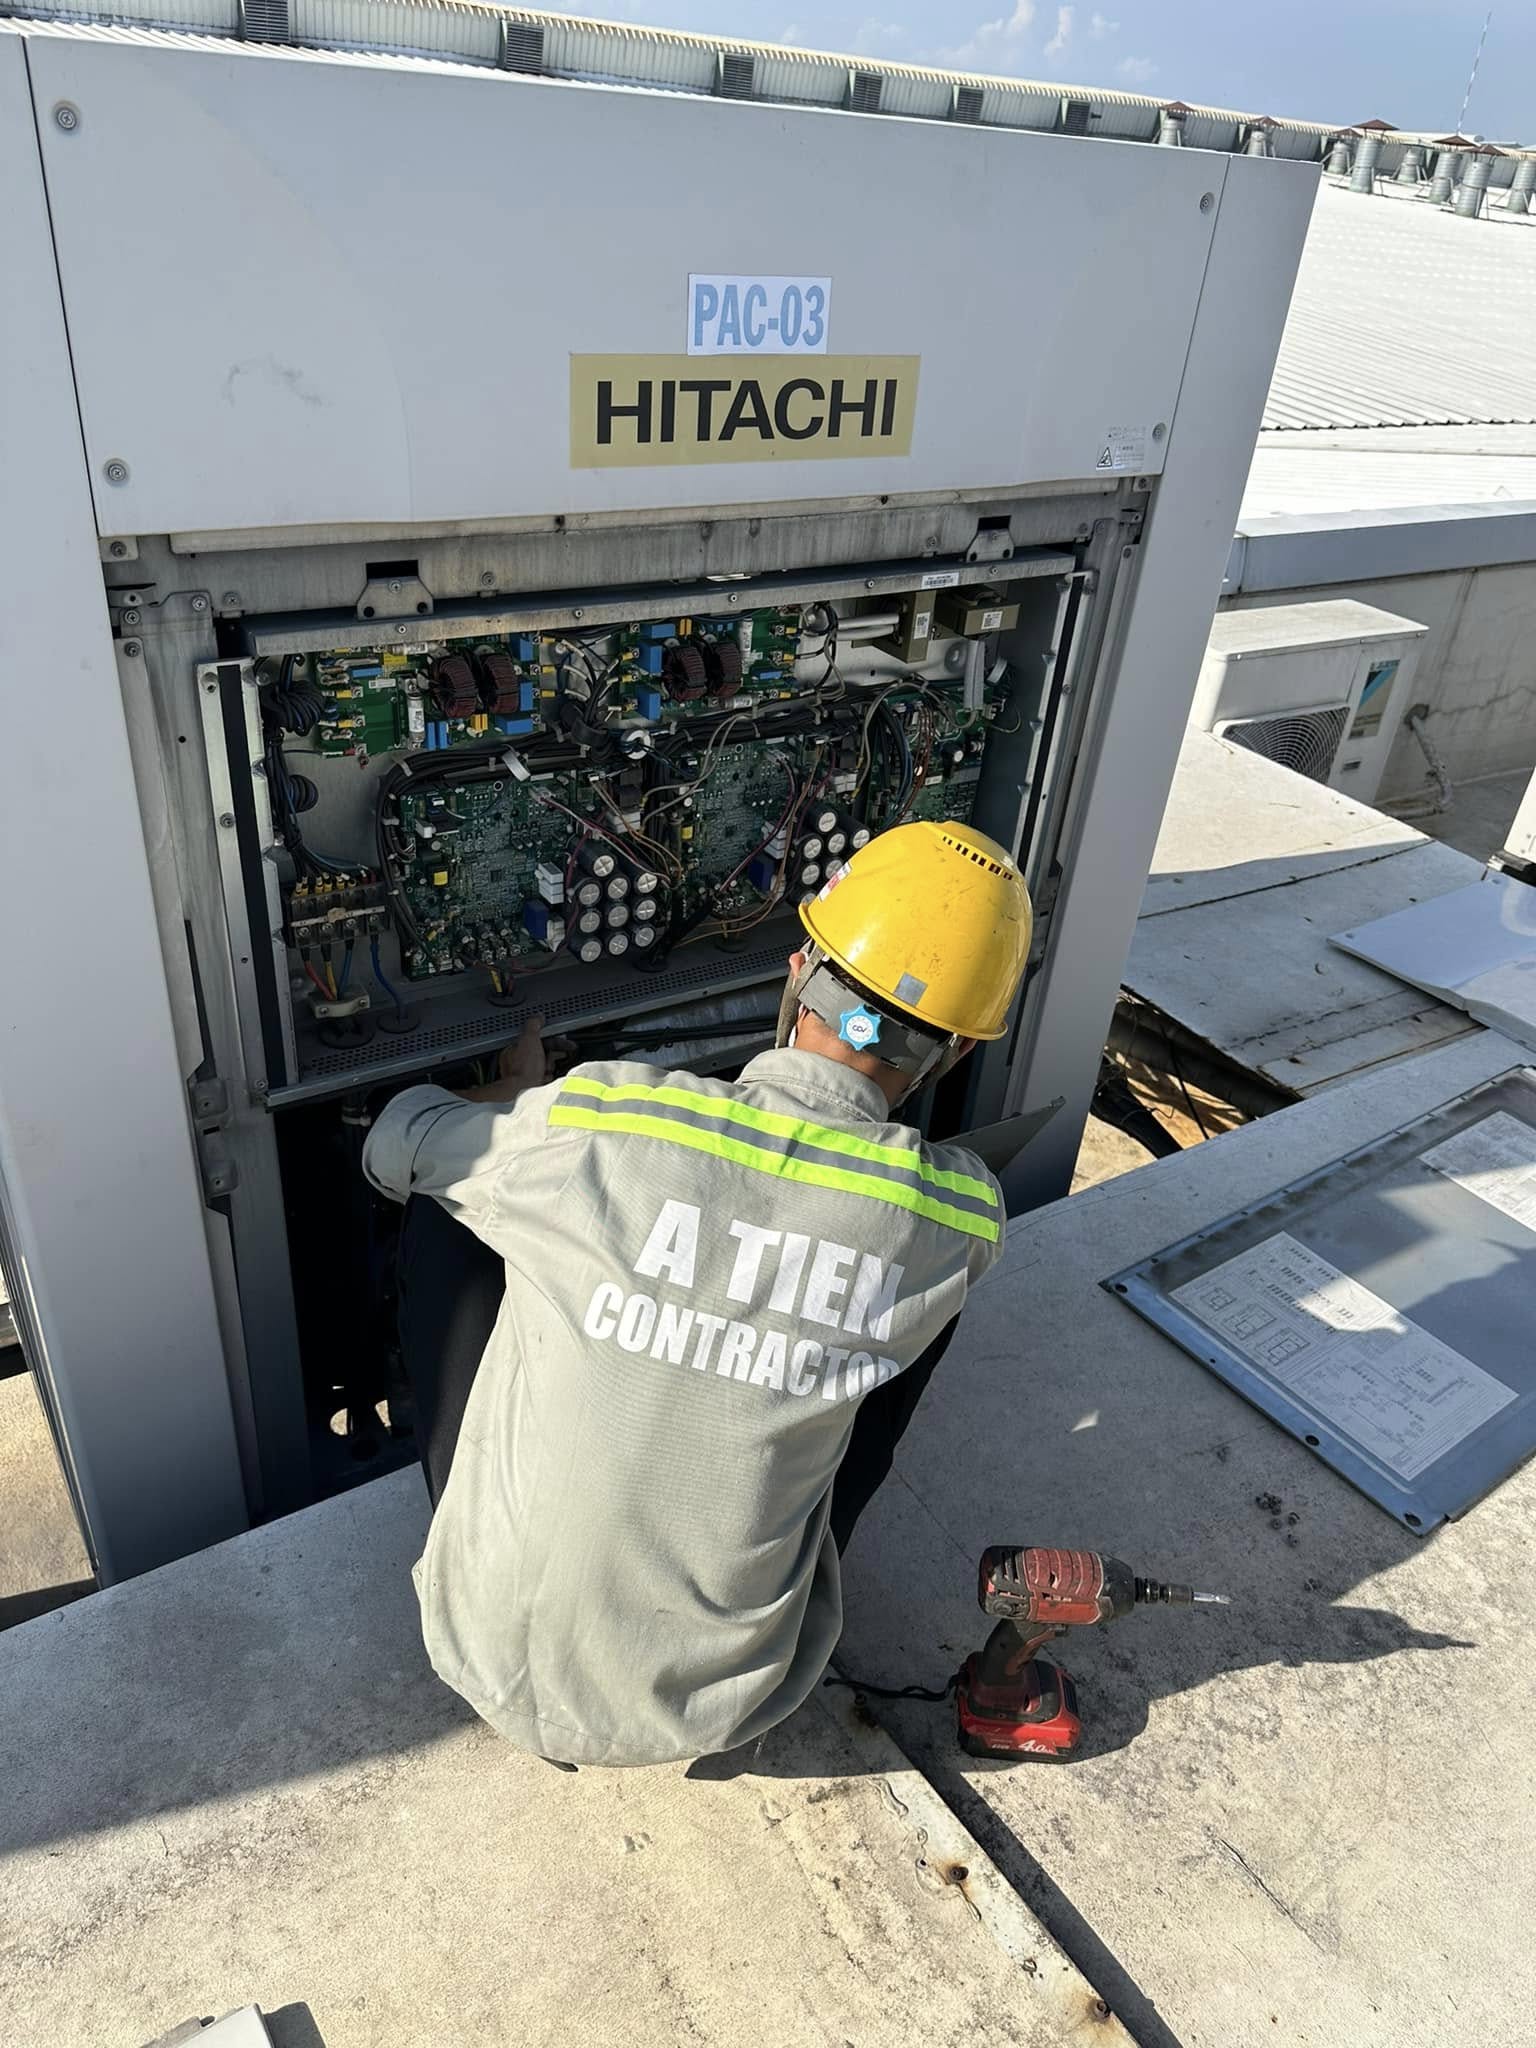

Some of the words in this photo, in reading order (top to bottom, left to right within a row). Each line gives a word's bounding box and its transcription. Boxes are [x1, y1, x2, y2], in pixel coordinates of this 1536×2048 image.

[693, 283, 826, 346] PAC-03
[597, 378, 898, 444] HITACHI
[633, 1198, 701, 1288] A
[726, 1218, 905, 1342] TIEN
